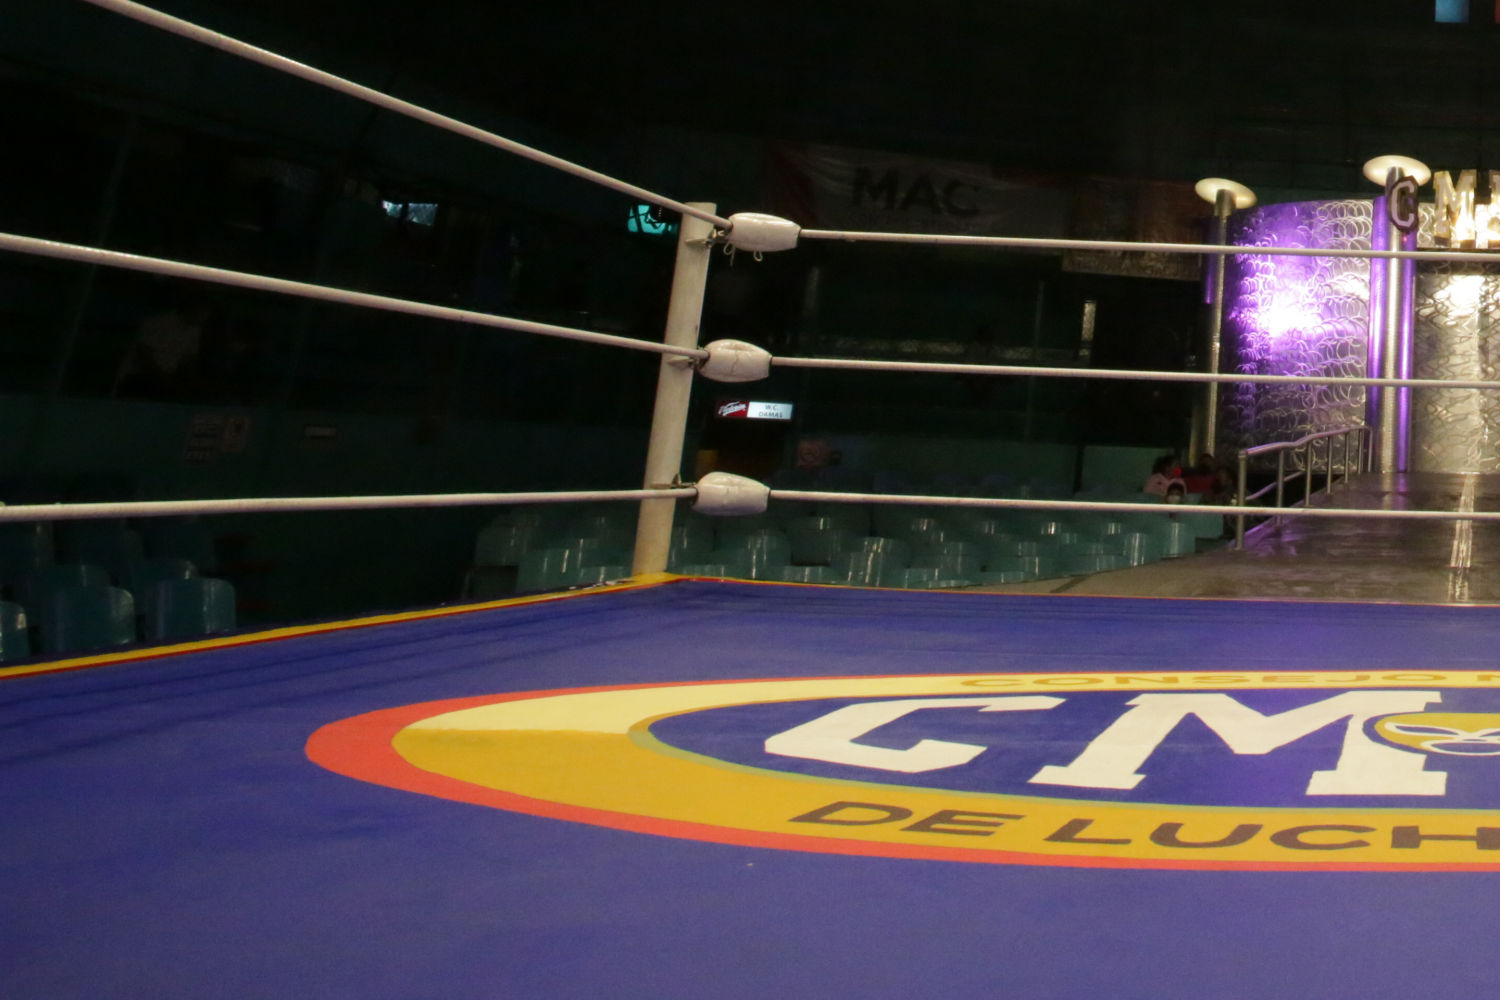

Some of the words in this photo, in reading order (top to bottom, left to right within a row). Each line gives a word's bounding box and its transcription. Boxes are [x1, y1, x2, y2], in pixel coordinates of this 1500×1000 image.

[851, 165, 980, 217] MAC
[959, 672, 1449, 688] CONSEJO
[788, 801, 1026, 837] DE
